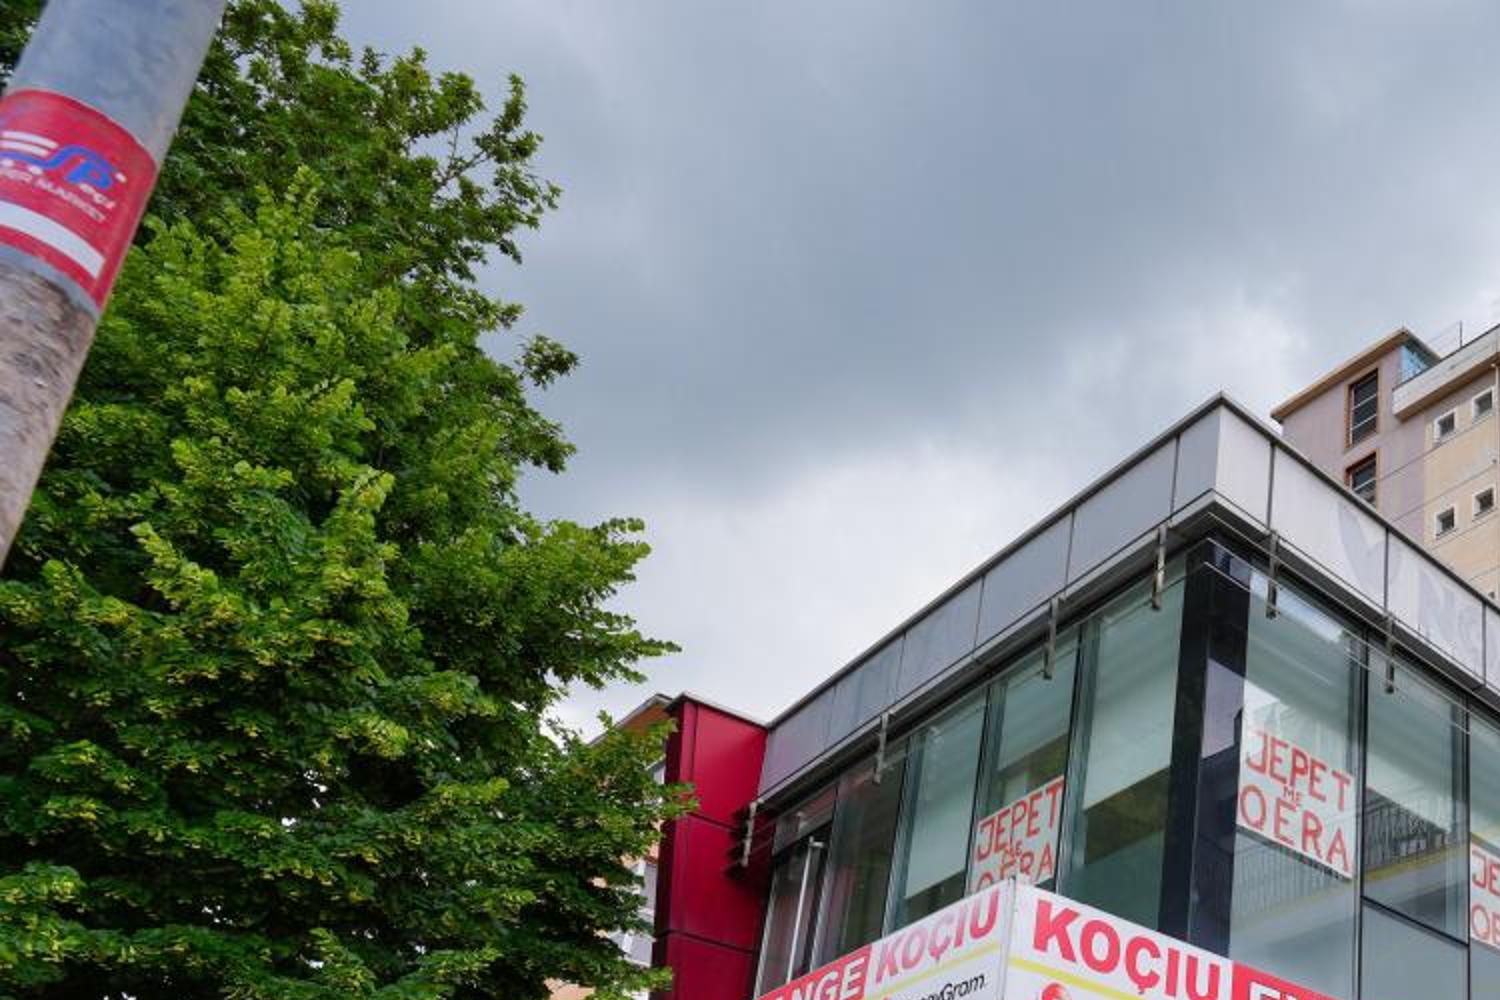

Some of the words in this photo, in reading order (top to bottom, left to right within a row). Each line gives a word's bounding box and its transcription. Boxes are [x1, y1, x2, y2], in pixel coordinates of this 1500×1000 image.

[1246, 730, 1353, 812] JEPET
[977, 780, 1064, 862] JEPET
[876, 888, 999, 983] KOÇIU
